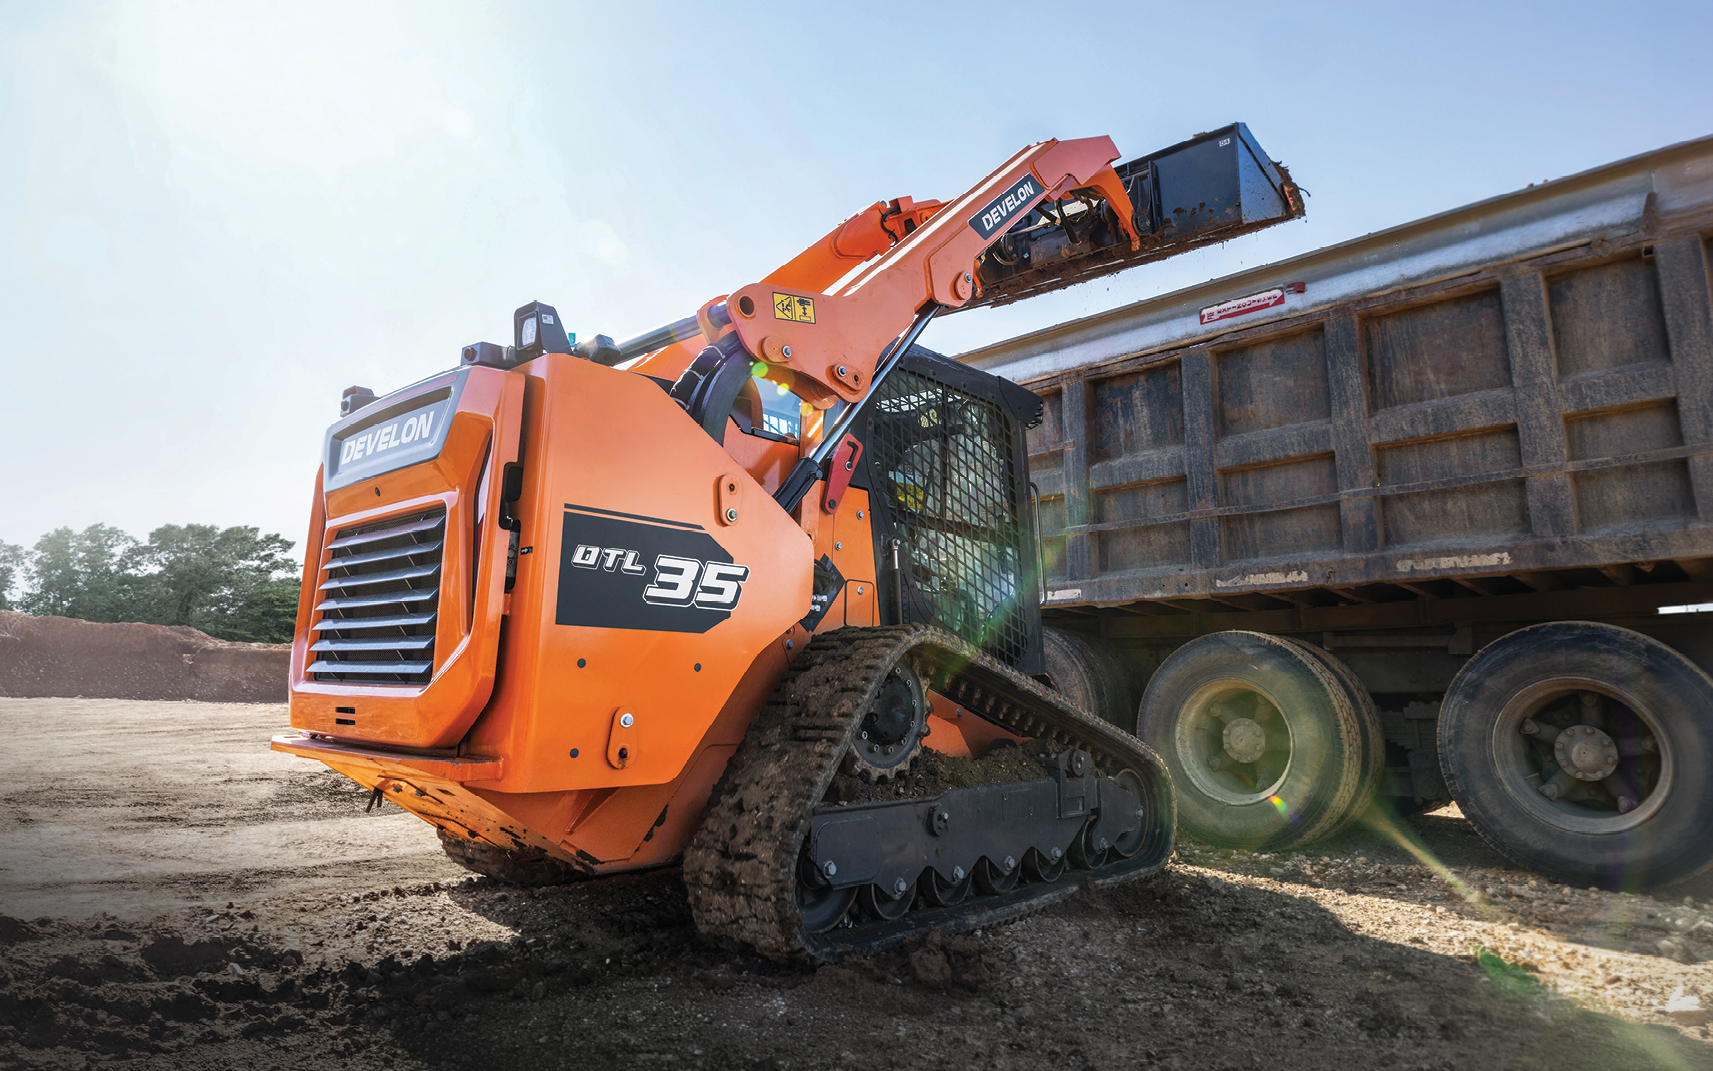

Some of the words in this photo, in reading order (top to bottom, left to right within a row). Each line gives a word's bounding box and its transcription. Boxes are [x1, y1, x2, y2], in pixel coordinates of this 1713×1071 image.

[981, 181, 1035, 231] DEVELON
[341, 410, 435, 466] DEVELON
[571, 544, 646, 576] DTL
[643, 554, 750, 611] 35
